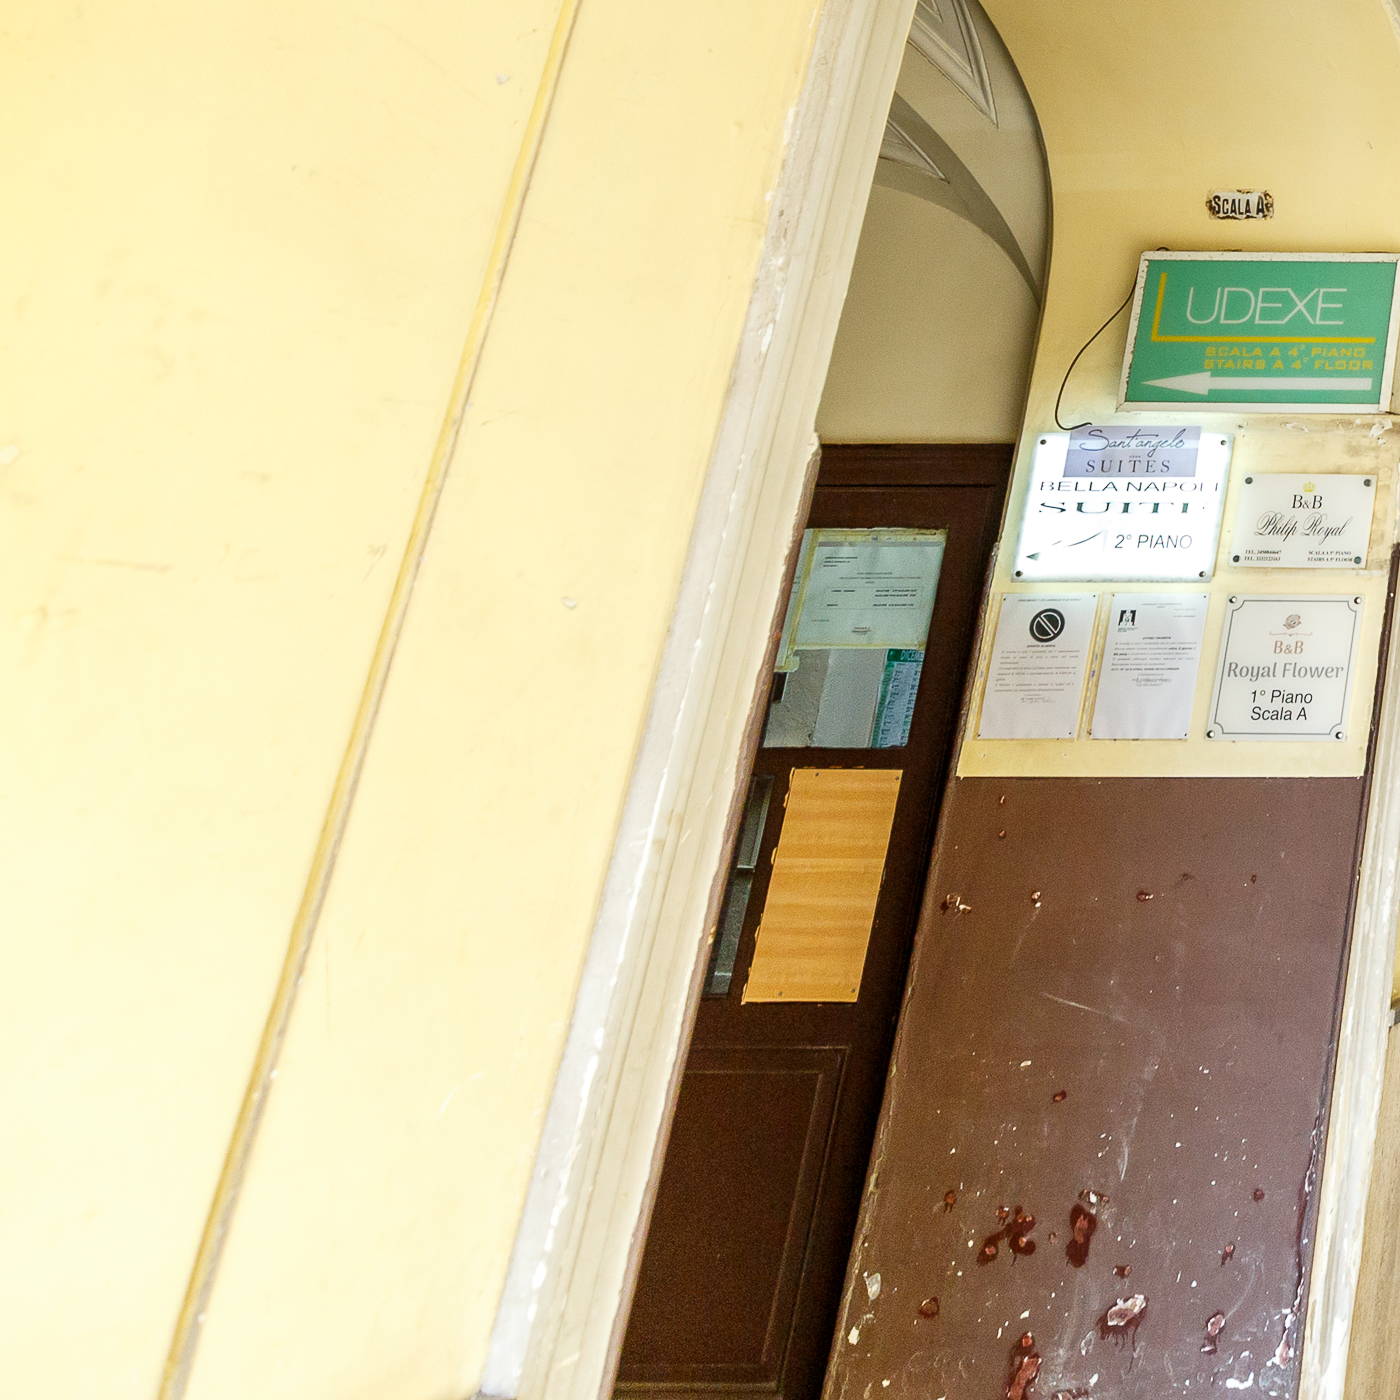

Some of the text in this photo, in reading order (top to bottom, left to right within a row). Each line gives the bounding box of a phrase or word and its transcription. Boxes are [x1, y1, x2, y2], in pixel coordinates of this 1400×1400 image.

[1212, 194, 1266, 216] SCALA A
[1205, 346, 1263, 357] SCALA
[1269, 346, 1281, 357] A
[1311, 346, 1366, 357] PIANO
[1203, 359, 1265, 370] STAIRS
[1272, 359, 1285, 370] A
[1314, 359, 1374, 370] FLOOR
[1085, 459, 1172, 473] SUITES
[1039, 481, 1118, 492] BELLA
[1292, 494, 1323, 509] B&B
[1254, 511, 1353, 545] Philip Royal
[1137, 534, 1193, 549] PIANO
[1273, 640, 1304, 655] B&B
[1227, 662, 1344, 682] Royal Flower
[1270, 690, 1313, 704] Piano
[1251, 706, 1307, 721] Scala A
